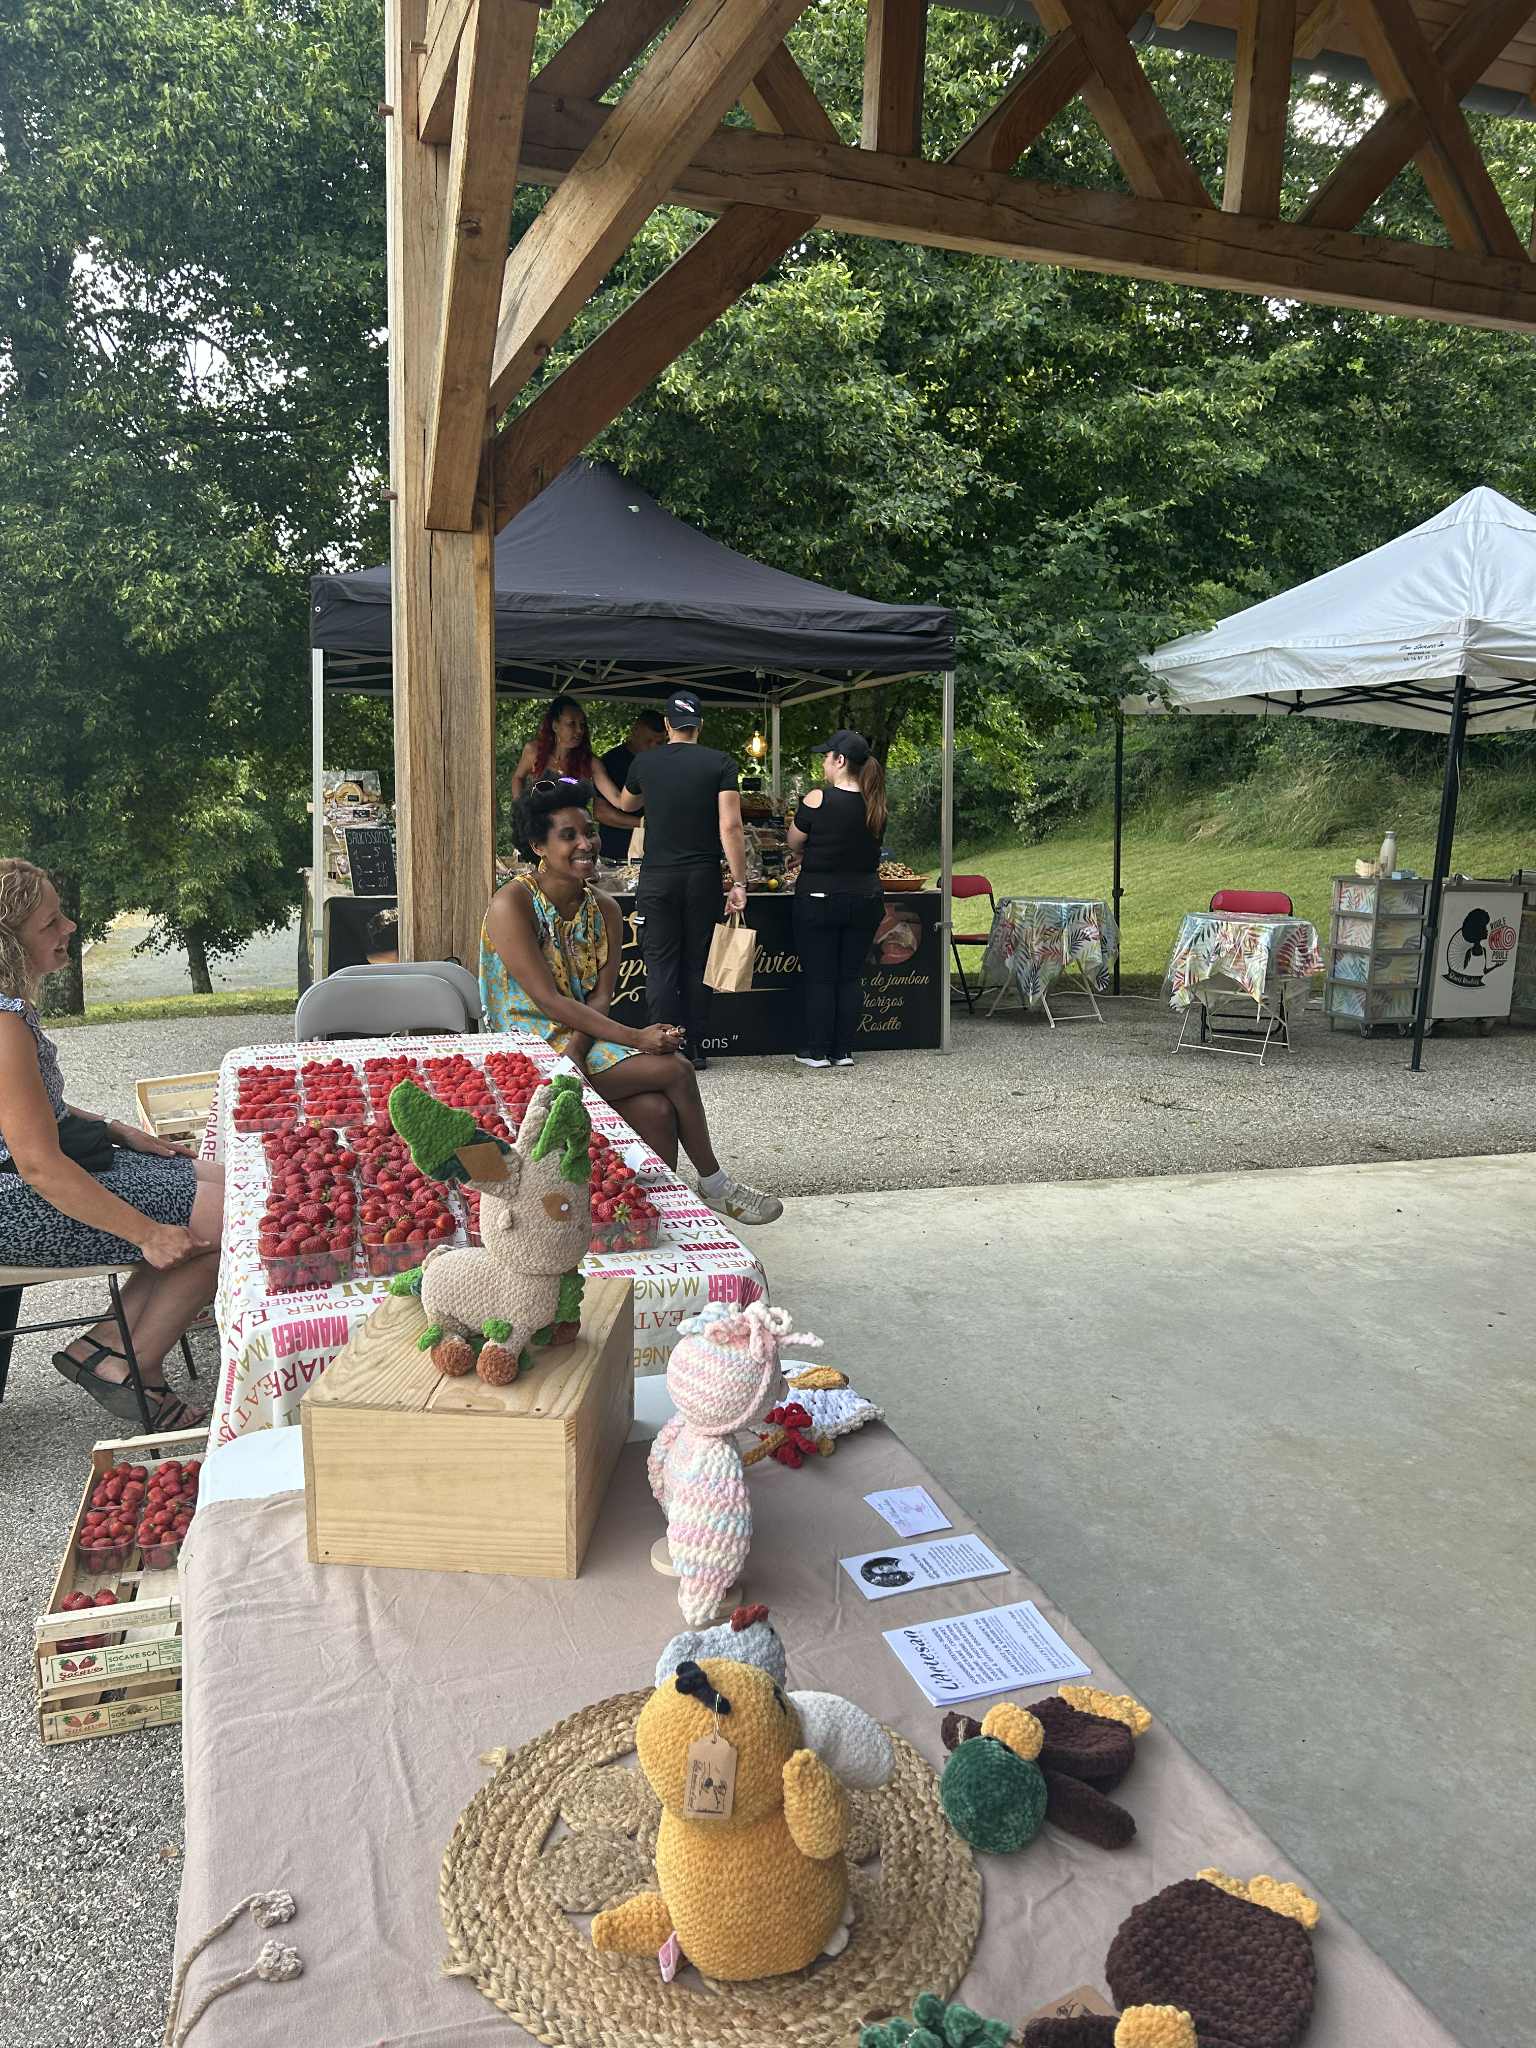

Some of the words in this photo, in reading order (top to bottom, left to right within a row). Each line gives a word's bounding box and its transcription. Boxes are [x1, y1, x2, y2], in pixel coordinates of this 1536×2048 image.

[752, 944, 802, 974] livier
[879, 970, 930, 993] jambon
[863, 991, 904, 1014] horizos
[701, 1037, 729, 1049] ons
[663, 1218, 720, 1230] GIAR
[678, 1241, 740, 1252] COMER
[682, 1251, 745, 1262] MANGER
[643, 1261, 705, 1277] EAT
[265, 1280, 334, 1297] COMER
[634, 1275, 701, 1301] MANG
[258, 1292, 329, 1309] MANGER
[287, 1299, 365, 1316] COMER
[634, 1308, 686, 1330] EAT
[271, 1314, 350, 1359] MANGER
[234, 1369, 274, 1430] EAT
[107, 1653, 140, 1663] SOCAVE
[142, 1650, 158, 1658] SCA
